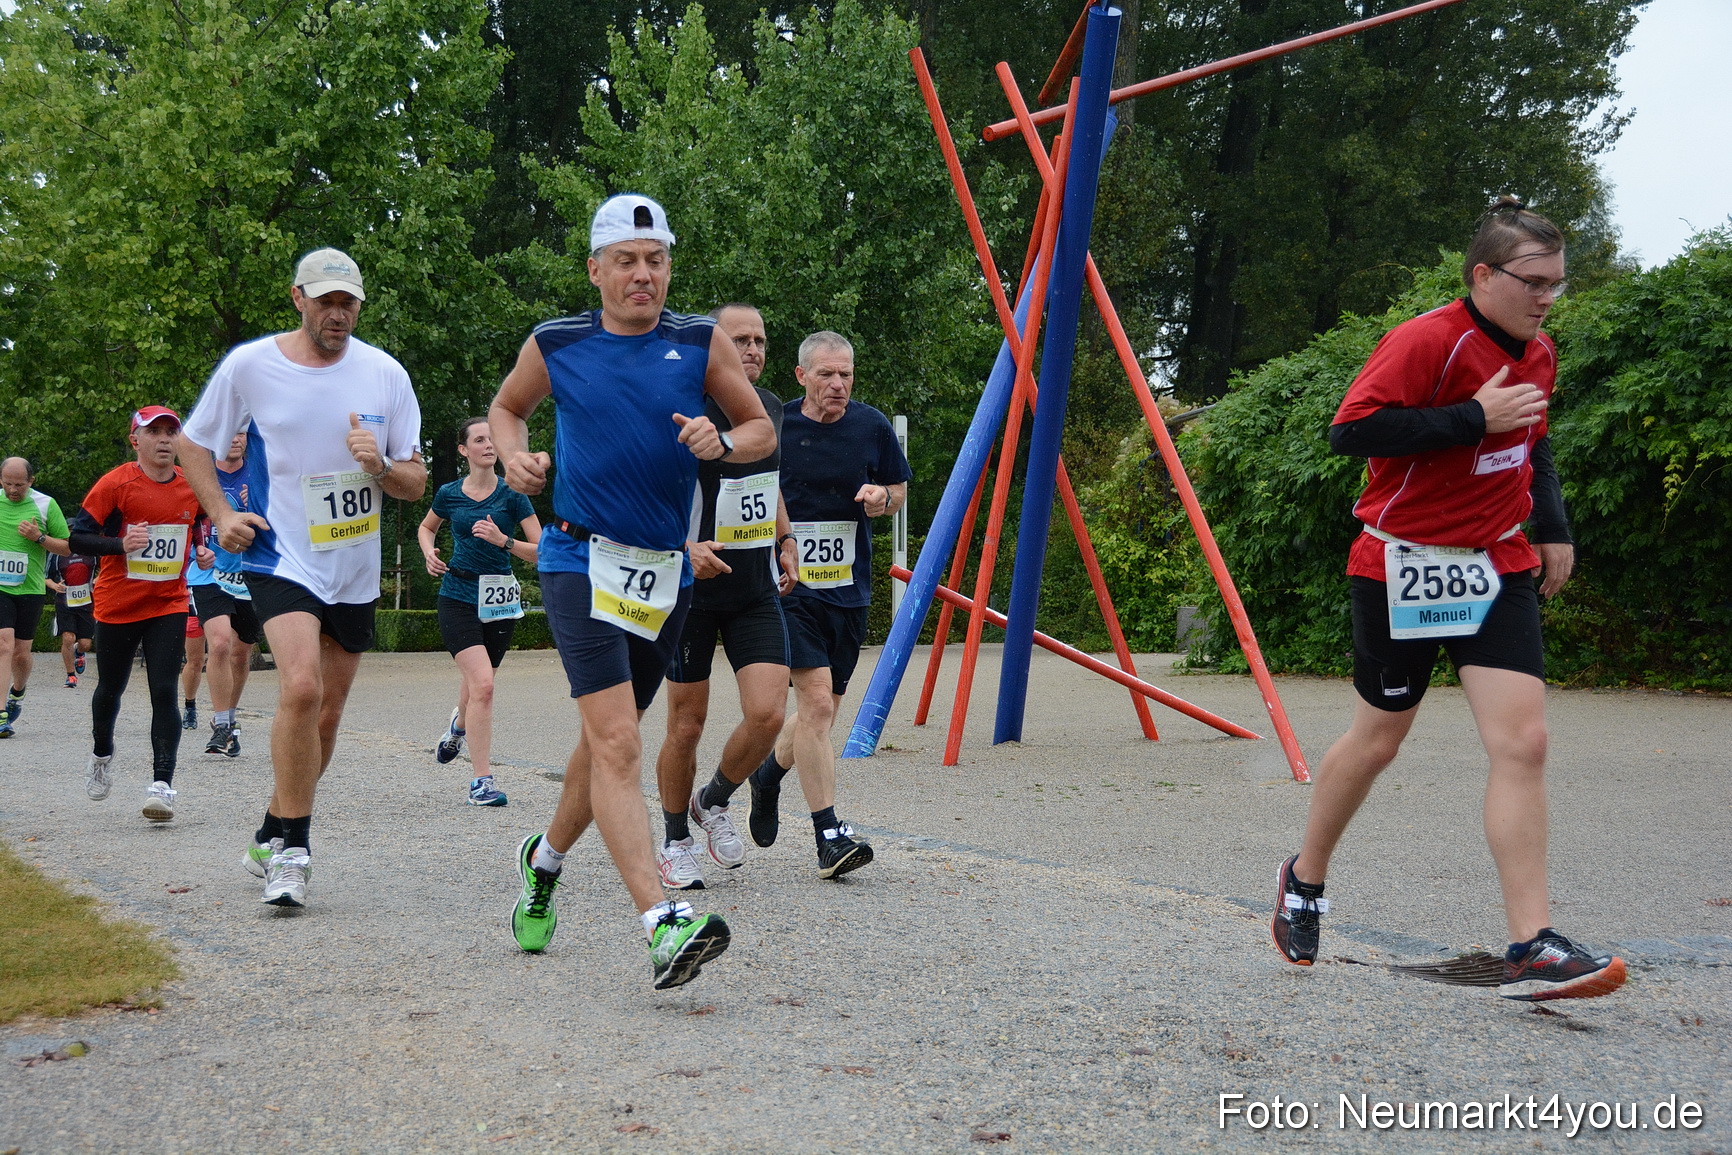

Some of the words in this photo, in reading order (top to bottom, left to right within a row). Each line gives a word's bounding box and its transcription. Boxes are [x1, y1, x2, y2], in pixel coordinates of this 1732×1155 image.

[1491, 454, 1512, 466] DEHN
[747, 475, 775, 489] BOCK
[324, 487, 372, 519] 180
[741, 493, 766, 522] 55
[331, 521, 370, 538] Gerhard
[733, 526, 773, 540] Matthias
[820, 524, 850, 533] BOCK
[141, 539, 177, 559] 280
[803, 538, 844, 563] 258
[147, 564, 169, 573] Oliver
[808, 570, 840, 580] Herbert
[619, 566, 656, 601] 79
[1399, 564, 1490, 601] 2583
[618, 601, 649, 623] Stefan
[1419, 607, 1472, 624] Manuel
